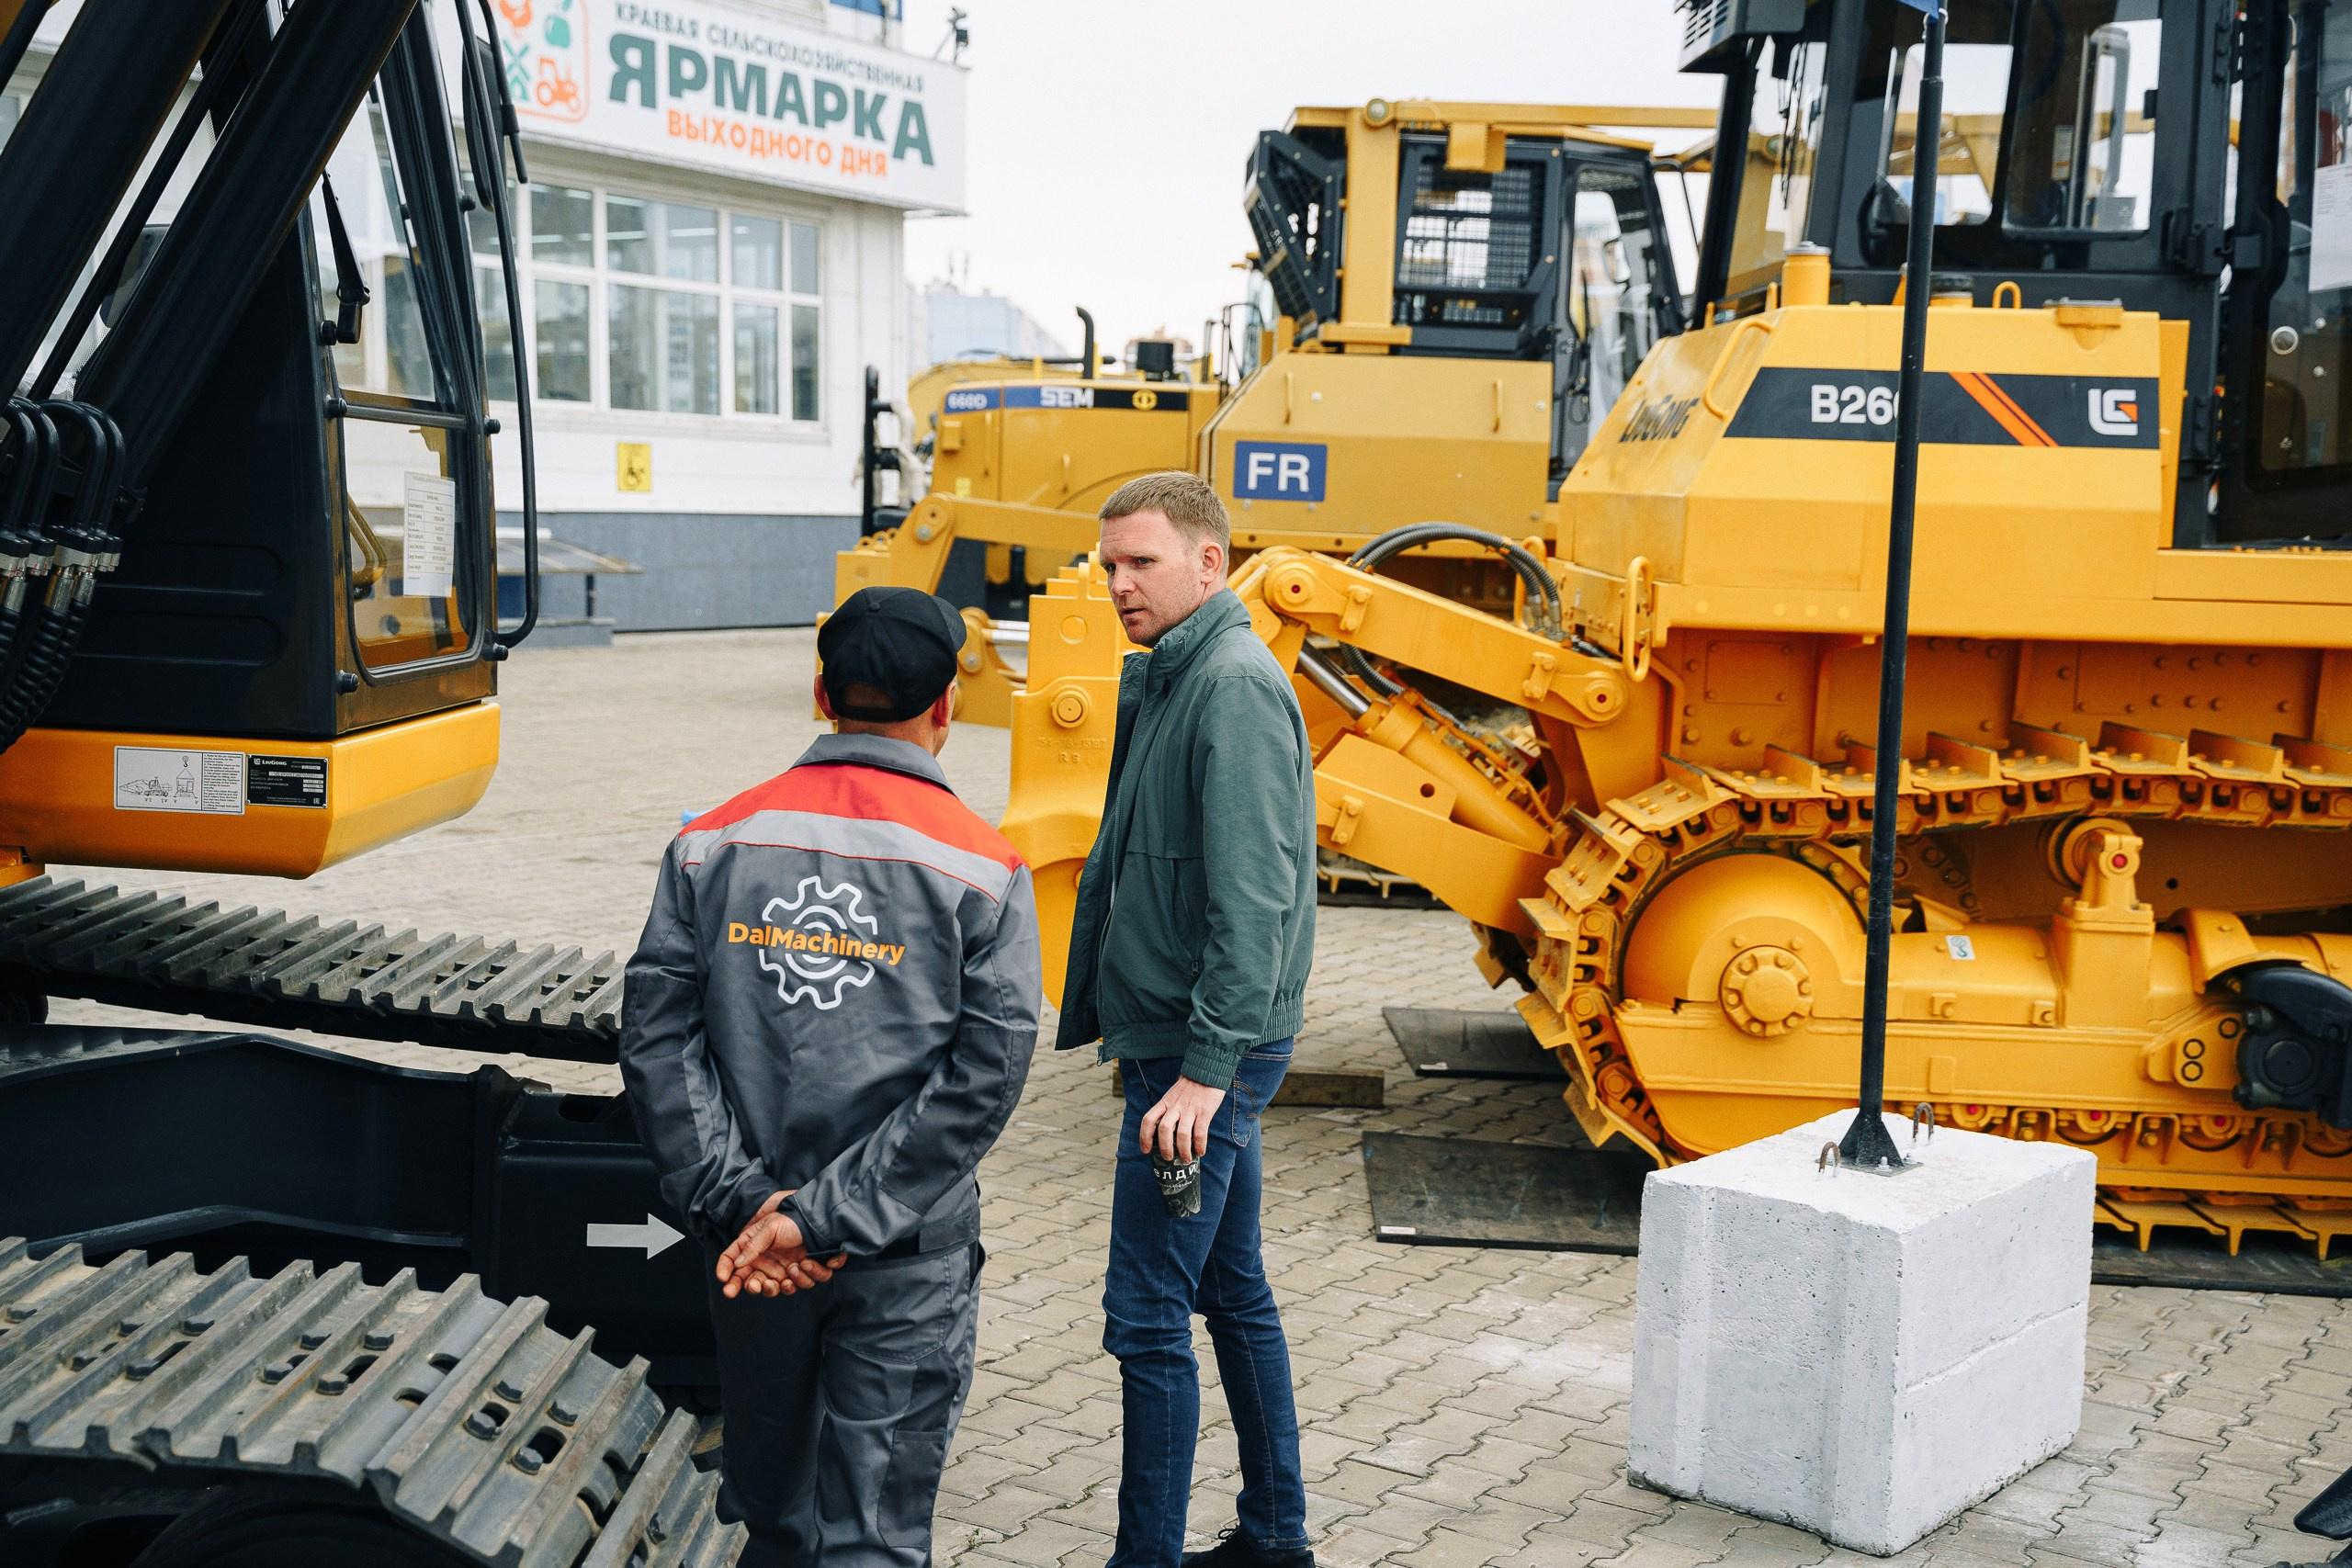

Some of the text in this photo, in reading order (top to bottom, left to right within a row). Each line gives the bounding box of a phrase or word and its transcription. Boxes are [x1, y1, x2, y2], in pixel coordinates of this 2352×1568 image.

[615, 3, 699, 39] КРАЕВАЯ
[608, 32, 934, 166] ЯРМАРКА
[667, 107, 888, 178] ВЫХОДНОГО ДНЯ
[1040, 386, 1094, 409] SEM
[1811, 384, 1900, 425] B26
[1247, 451, 1311, 493] FR
[728, 921, 907, 966] DalMachinery
